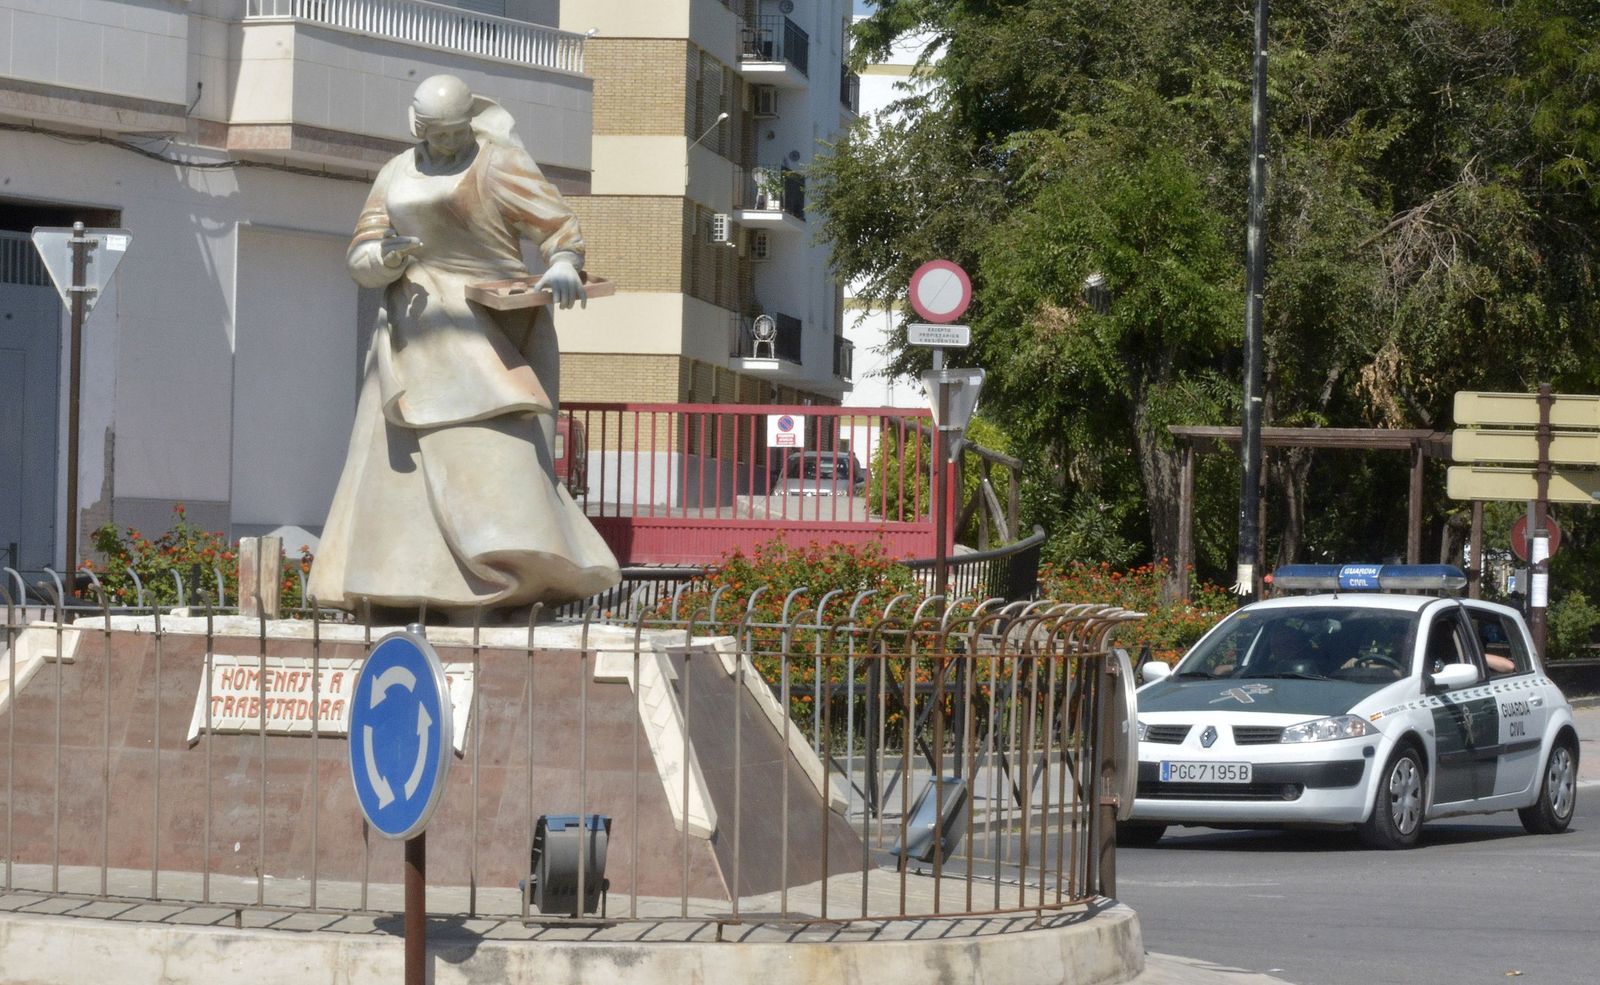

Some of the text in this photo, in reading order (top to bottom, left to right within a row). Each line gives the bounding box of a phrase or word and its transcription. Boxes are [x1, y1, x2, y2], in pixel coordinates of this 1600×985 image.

[1344, 567, 1376, 575] GUARDIA
[1350, 578, 1369, 587] CIVIL
[221, 668, 323, 693] HOMENAJE
[329, 671, 344, 694] A
[210, 696, 345, 720] TRABAJADORA
[1502, 700, 1531, 718] GUARDIA
[1510, 720, 1526, 737] CIVIL
